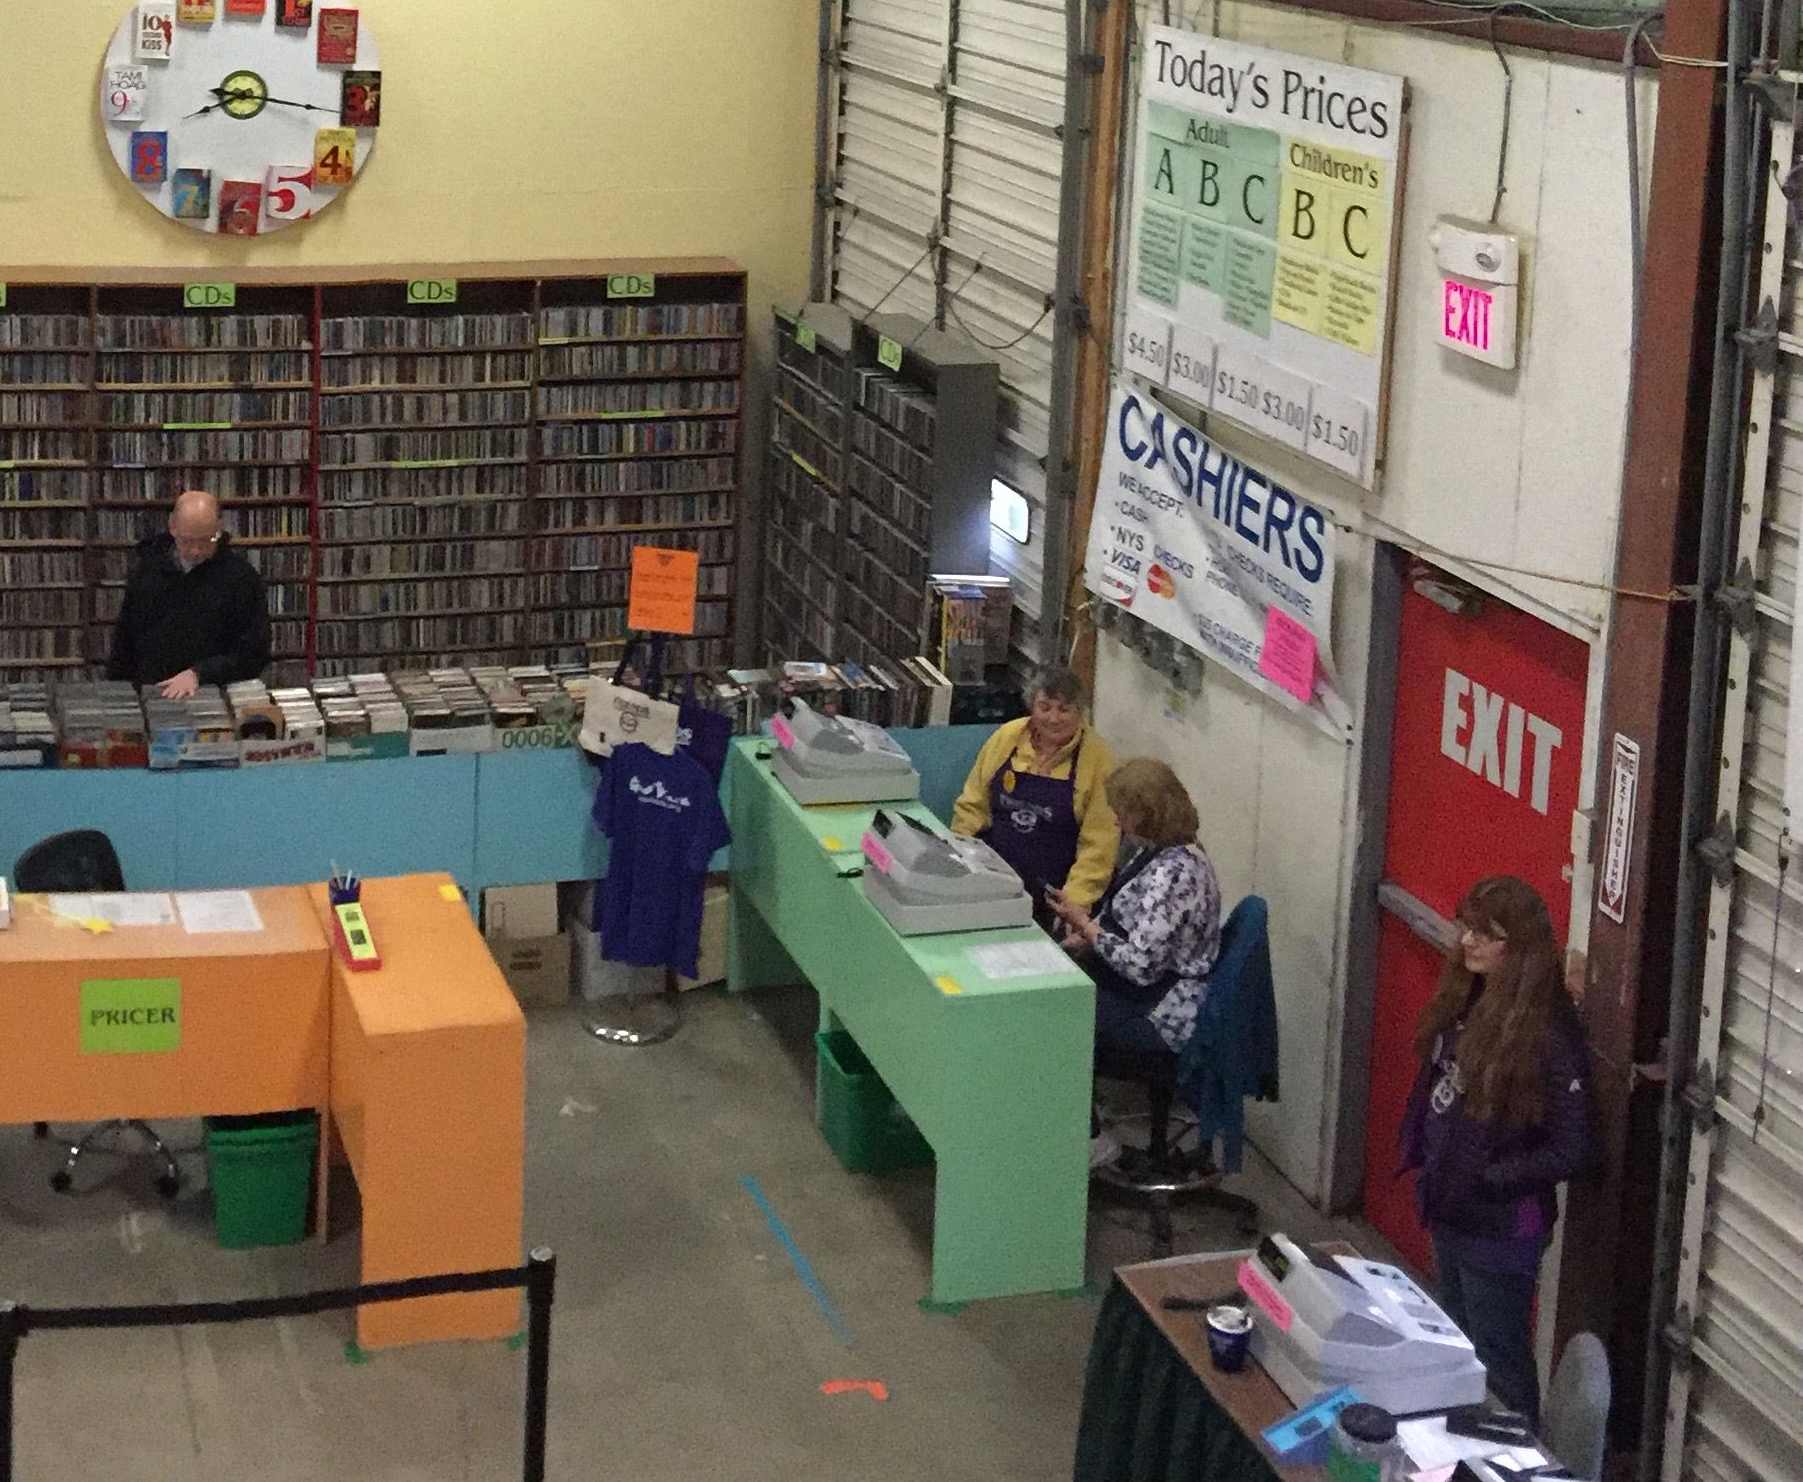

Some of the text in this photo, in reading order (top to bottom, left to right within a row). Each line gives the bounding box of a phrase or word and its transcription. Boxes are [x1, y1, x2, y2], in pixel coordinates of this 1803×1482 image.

[142, 13, 161, 31] 10
[141, 39, 162, 51] KISS
[110, 79, 145, 91] HOAG
[115, 70, 143, 81] TAMI
[1155, 39, 1389, 139] Today's Prices
[110, 90, 128, 117] 9
[345, 85, 367, 111] 3
[1186, 117, 1230, 149] Adult
[136, 140, 163, 180] 8
[319, 145, 341, 176] 4
[1154, 148, 1175, 195] A
[1290, 142, 1379, 189] Children's
[180, 183, 199, 215] 7
[268, 167, 313, 219] 5
[1197, 159, 1220, 207] B
[1242, 174, 1265, 225] C
[1291, 188, 1315, 241] B
[1343, 205, 1370, 260] C
[186, 284, 233, 306] CDs
[409, 281, 455, 303] CDs
[607, 275, 653, 296] CDs
[1444, 279, 1493, 351] EXIT
[1128, 332, 1164, 367] $4.50
[1174, 352, 1211, 389] $3.00
[1217, 371, 1259, 410] $1.50
[1262, 391, 1305, 432] $3.00
[1312, 414, 1359, 457] $1.50
[1119, 471, 1139, 493] WE
[1119, 394, 1325, 584] CASHIERS
[1116, 525, 1145, 552] NYS
[1111, 550, 1142, 576] VISA
[1440, 666, 1564, 816] EXIT
[89, 1004, 177, 1027] PRICER
